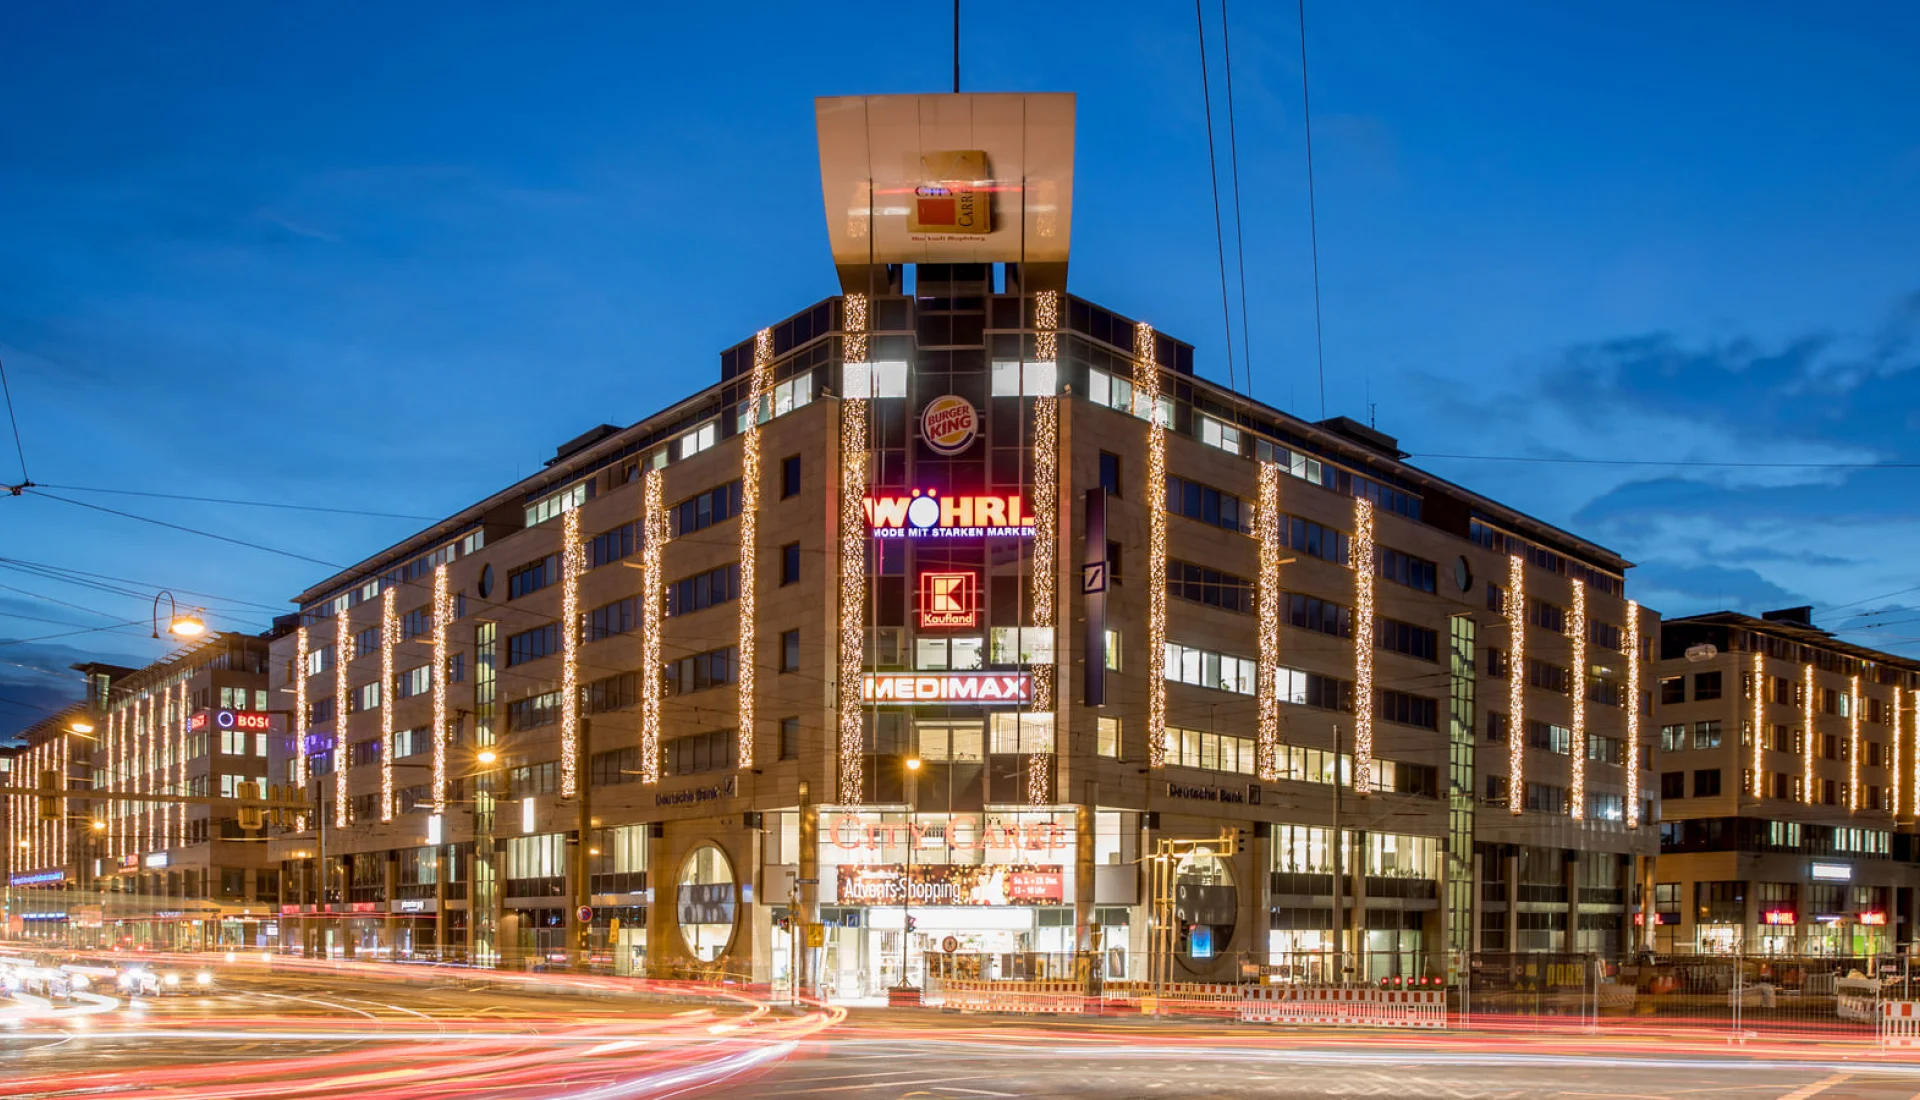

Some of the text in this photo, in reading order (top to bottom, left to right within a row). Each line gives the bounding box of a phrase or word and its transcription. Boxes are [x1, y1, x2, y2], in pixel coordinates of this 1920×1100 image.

[928, 405, 970, 427] BURGER
[930, 415, 972, 441] KING
[864, 488, 1035, 528] WÖHRL
[908, 528, 928, 538] MIT
[932, 528, 984, 537] STARKEN
[987, 527, 1035, 537] MARKEN
[924, 613, 972, 624] Kaufland
[865, 677, 1027, 699] MEDIMAX
[1168, 783, 1244, 803] Deutsche Bank
[829, 814, 1067, 851] CITY CARRÉ
[843, 876, 961, 902] Advents-Shopping
